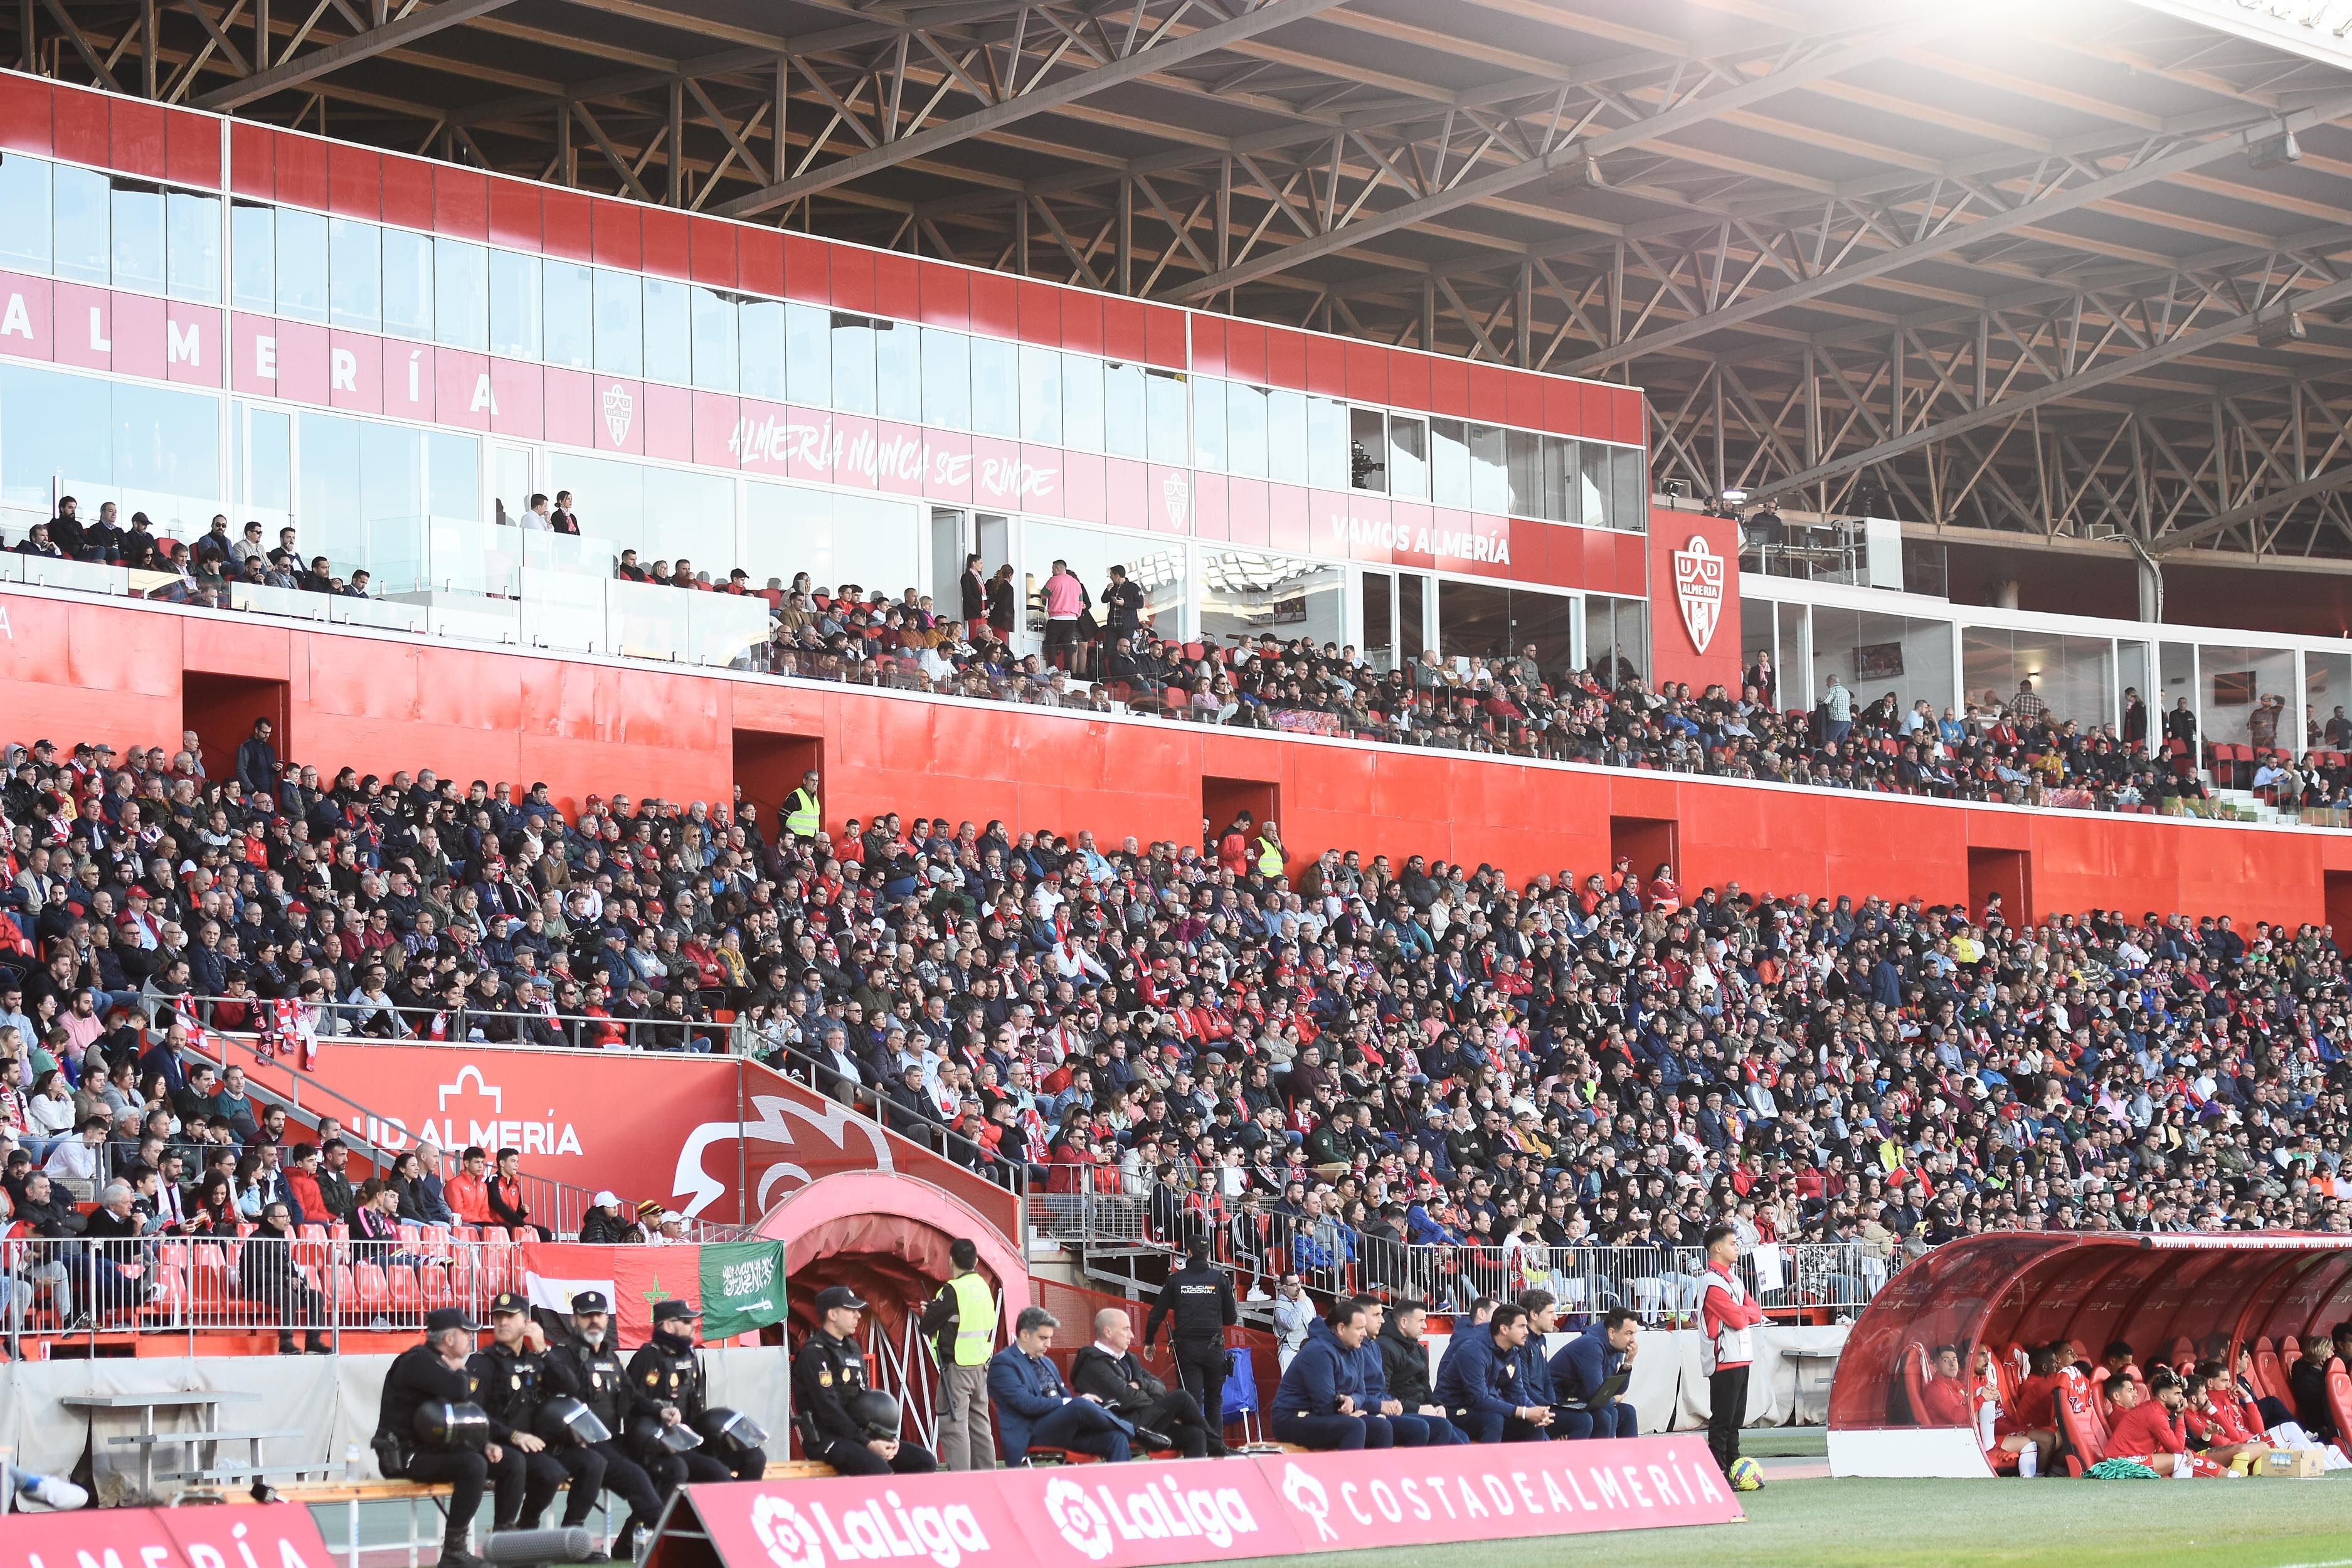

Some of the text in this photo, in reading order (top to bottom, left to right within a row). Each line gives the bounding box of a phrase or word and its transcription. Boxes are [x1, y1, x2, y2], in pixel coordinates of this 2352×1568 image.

[1, 293, 499, 416] ALMERÍA
[728, 414, 1059, 497] ALMERÍA NUNCA SE RINDE
[1331, 514, 1511, 565] VAMOS ALMERÍA
[1682, 583, 1718, 598] ALMERIA
[416, 1109, 583, 1156] ALMERÍA
[1097, 1474, 1259, 1548] LaLiga
[1340, 1449, 1724, 1526] COSTADEALMERÍA
[810, 1490, 991, 1568] LaLiga
